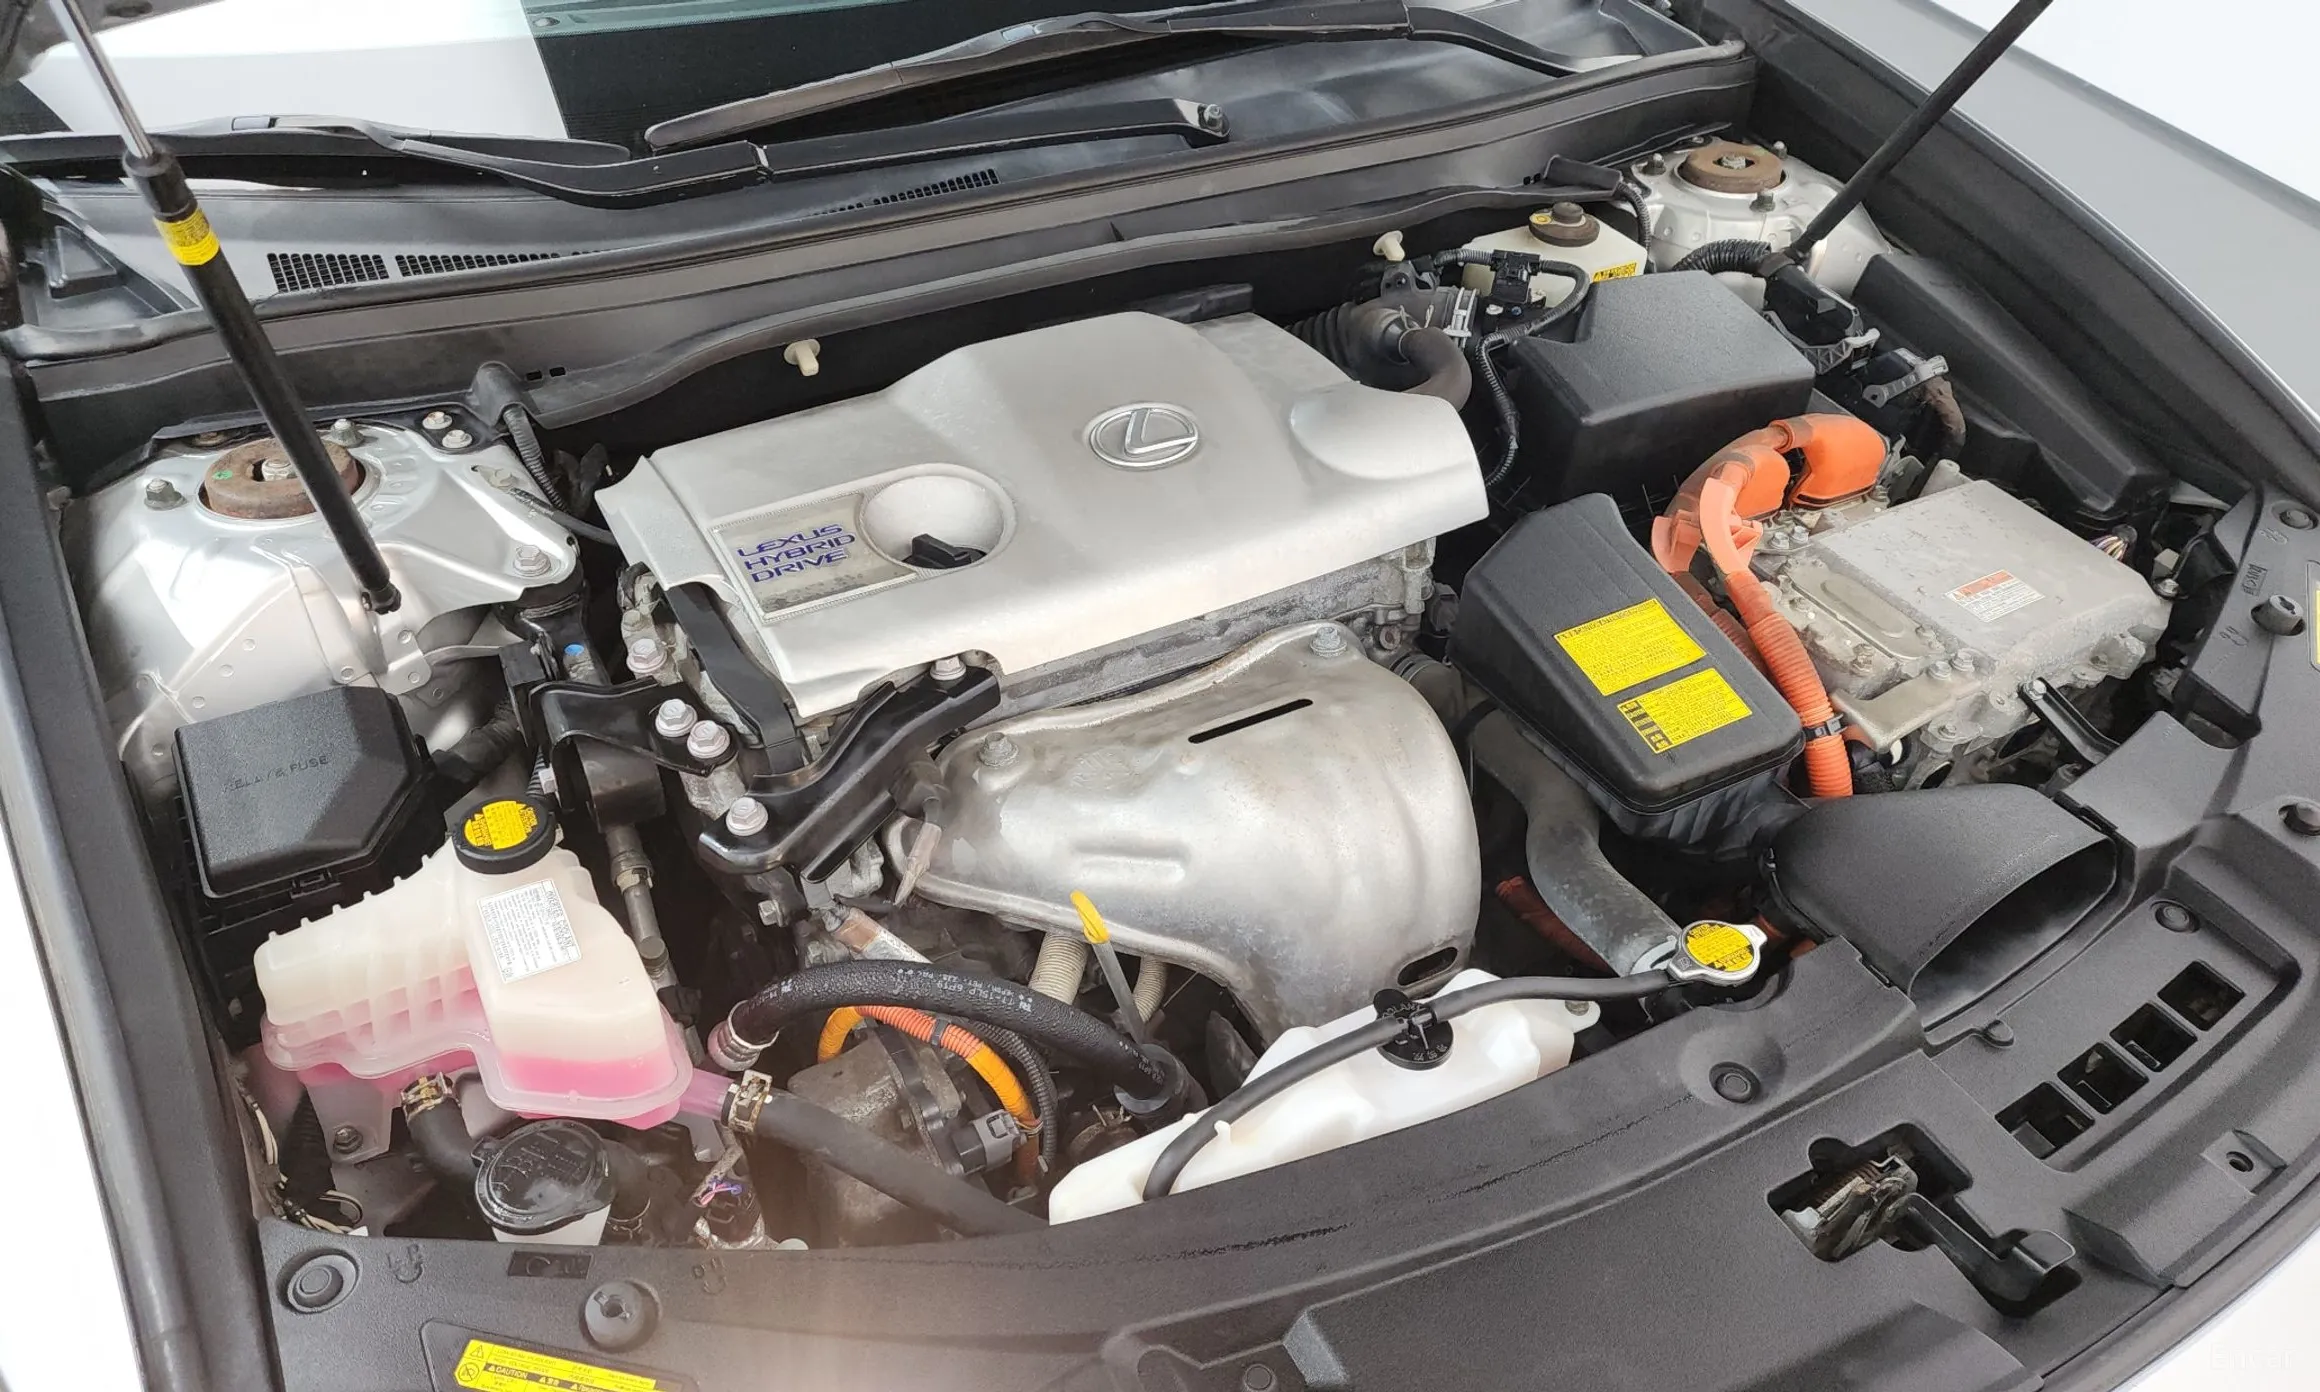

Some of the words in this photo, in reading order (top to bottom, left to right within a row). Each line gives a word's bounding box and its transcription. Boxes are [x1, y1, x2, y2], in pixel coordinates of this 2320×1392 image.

[737, 523, 843, 557] LEXUS
[744, 534, 856, 571] HYBRID
[751, 547, 849, 583] DRIVE
[289, 755, 329, 773] FUSE
[495, 1366, 528, 1380] CAUTION
